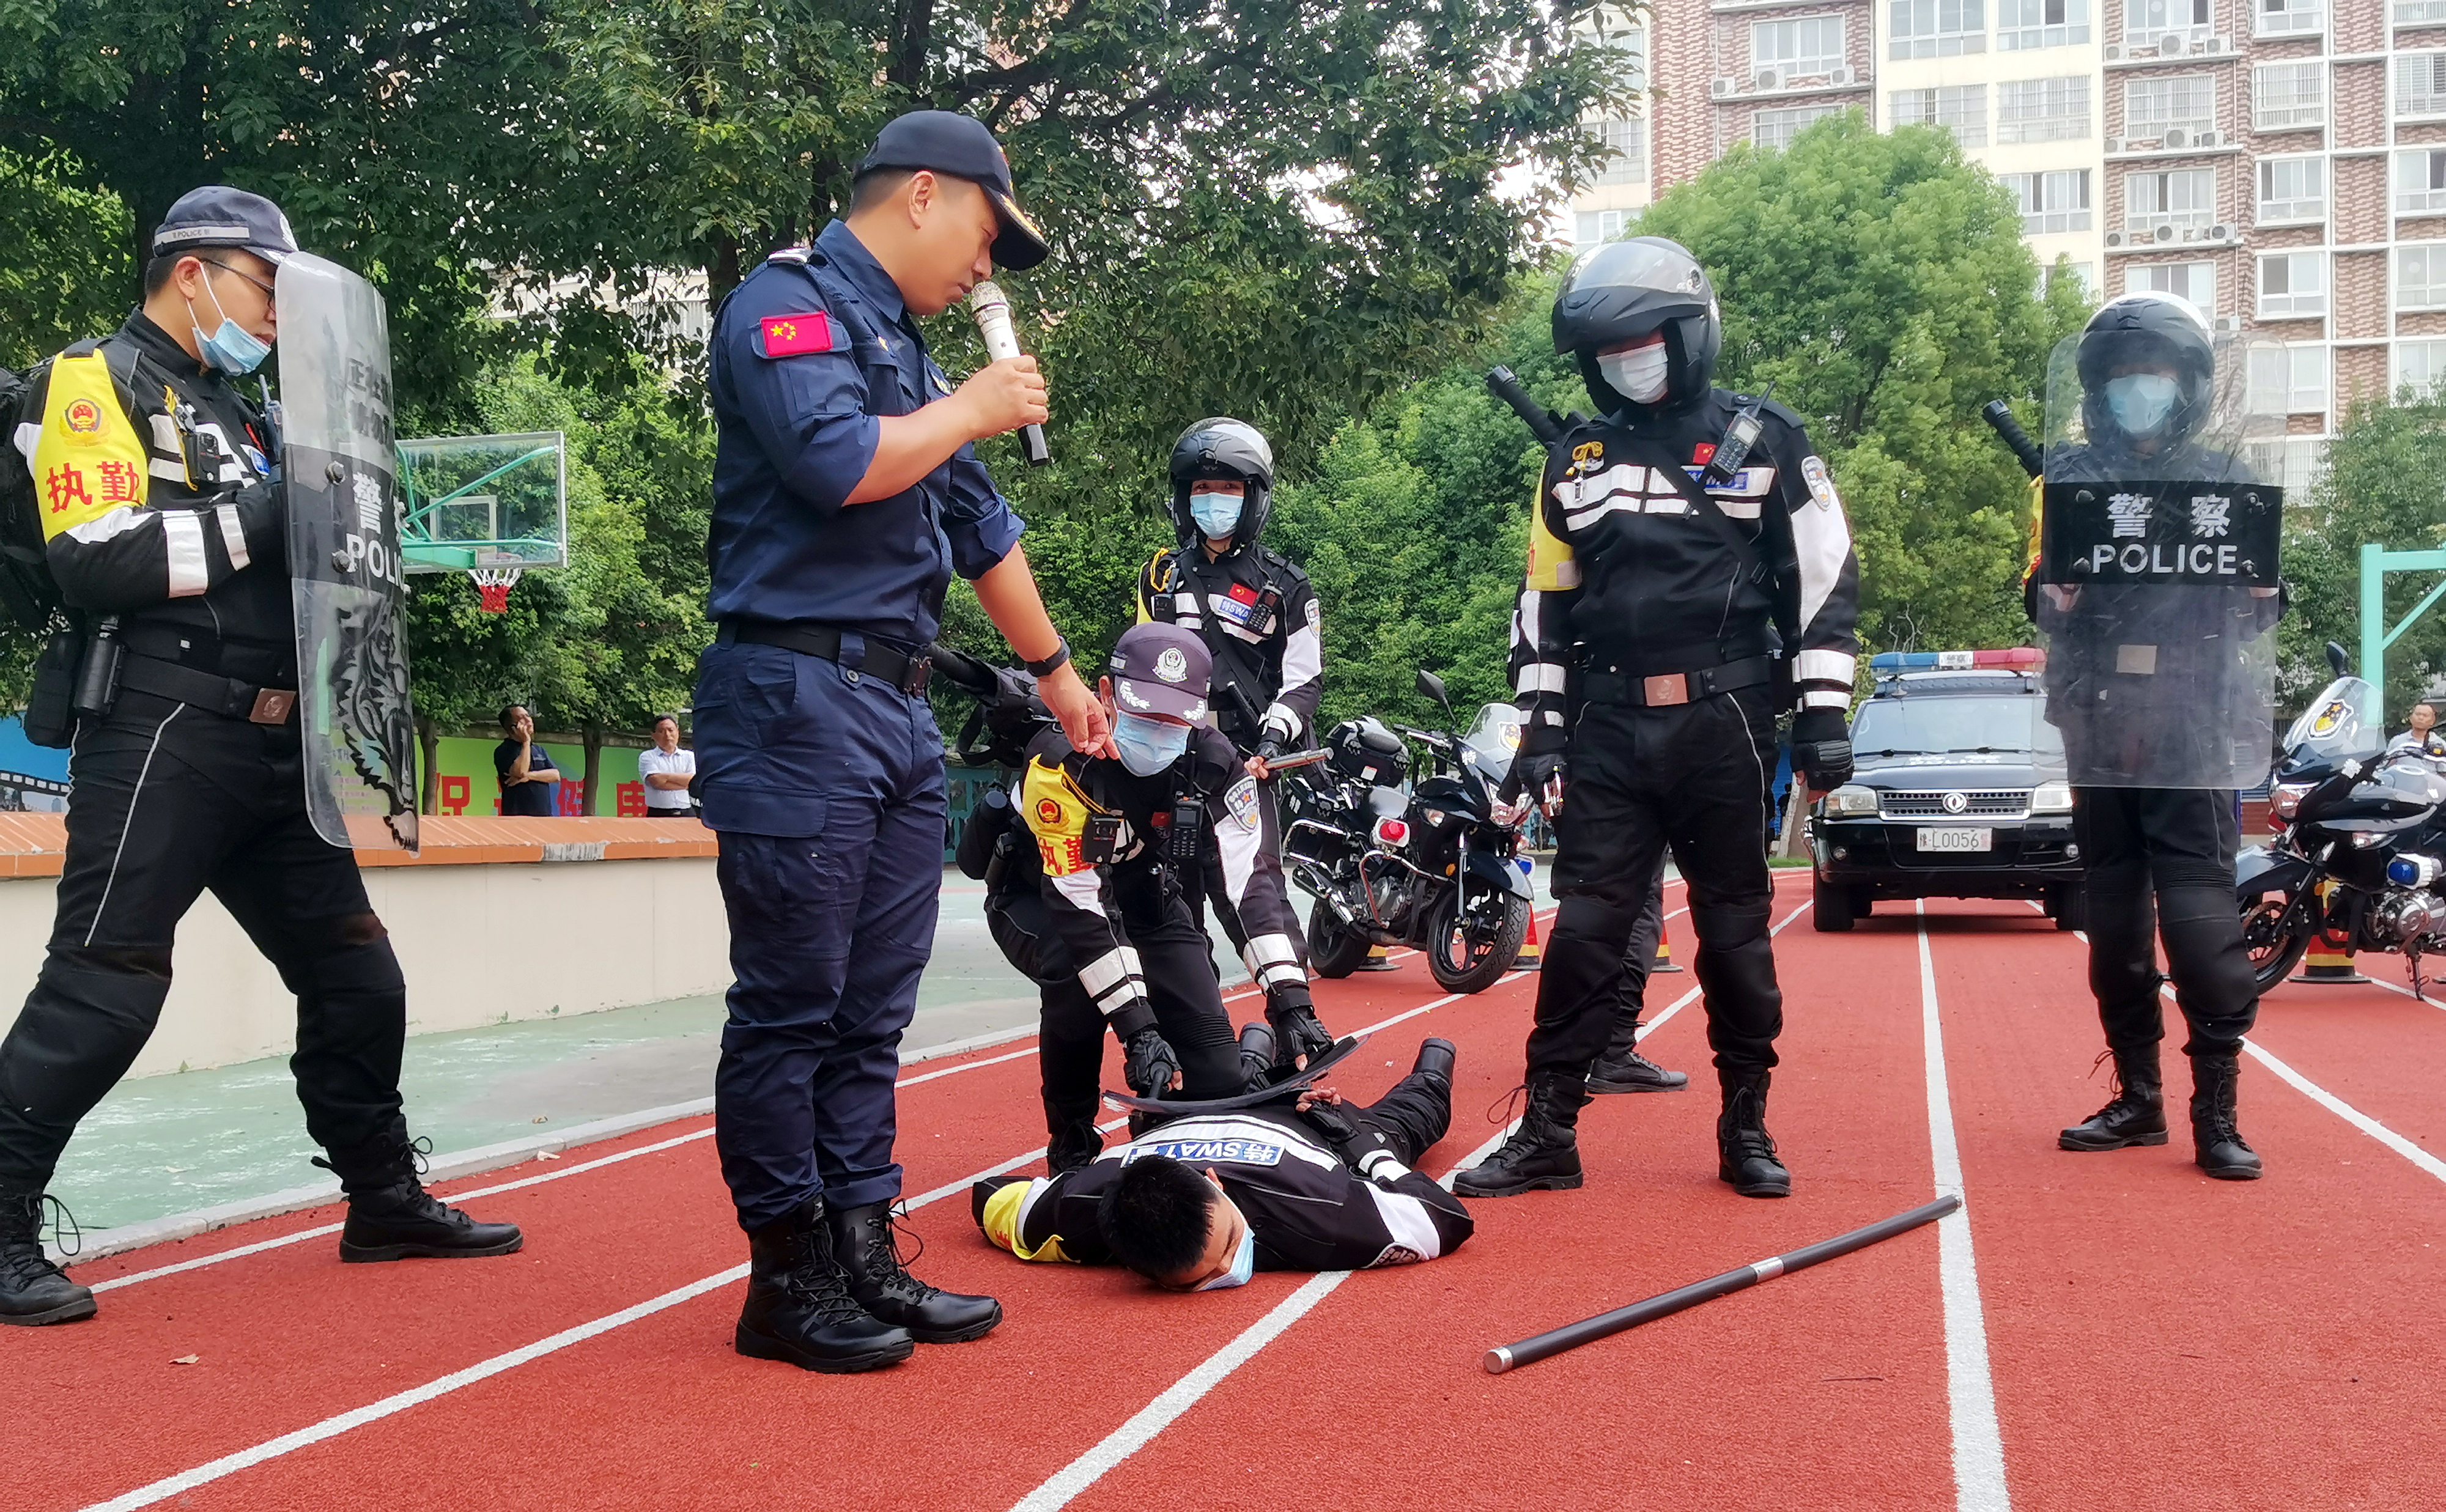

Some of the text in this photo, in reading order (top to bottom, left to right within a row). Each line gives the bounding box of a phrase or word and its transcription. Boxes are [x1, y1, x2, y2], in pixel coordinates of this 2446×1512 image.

[46, 461, 141, 514] 执勤
[2107, 493, 2231, 538] 警察
[2093, 544, 2237, 573] POLICE
[1461, 750, 1477, 765] 特
